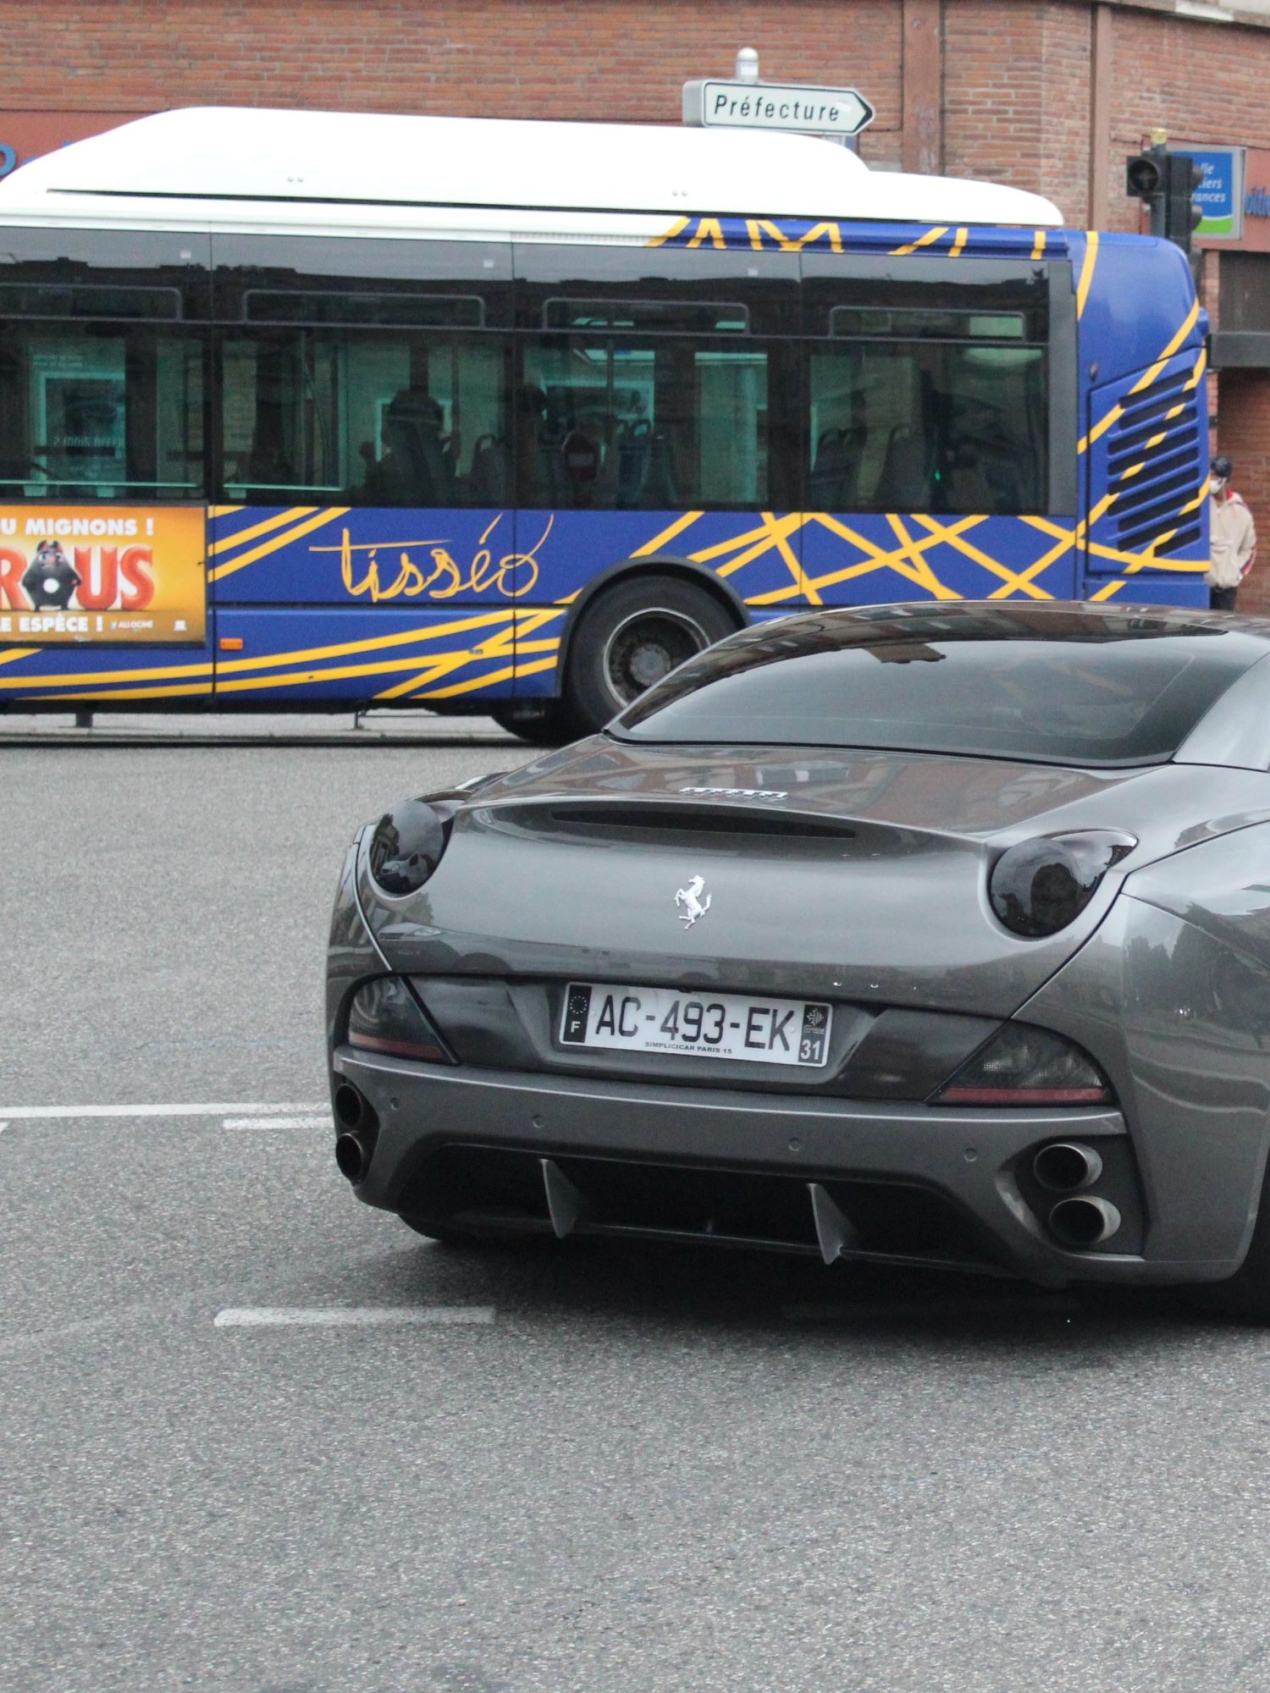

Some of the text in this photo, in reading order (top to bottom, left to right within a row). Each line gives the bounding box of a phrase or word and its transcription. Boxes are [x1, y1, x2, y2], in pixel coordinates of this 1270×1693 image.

[714, 94, 839, 122] Préfecture
[1191, 192, 1226, 203] rances
[25, 518, 138, 536] MIGNONS
[19, 612, 89, 632] ESPÈCE
[570, 1021, 582, 1033] F
[595, 994, 796, 1052] AC-493-EK
[800, 1039, 821, 1061] 31
[697, 1045, 721, 1053] PARIS
